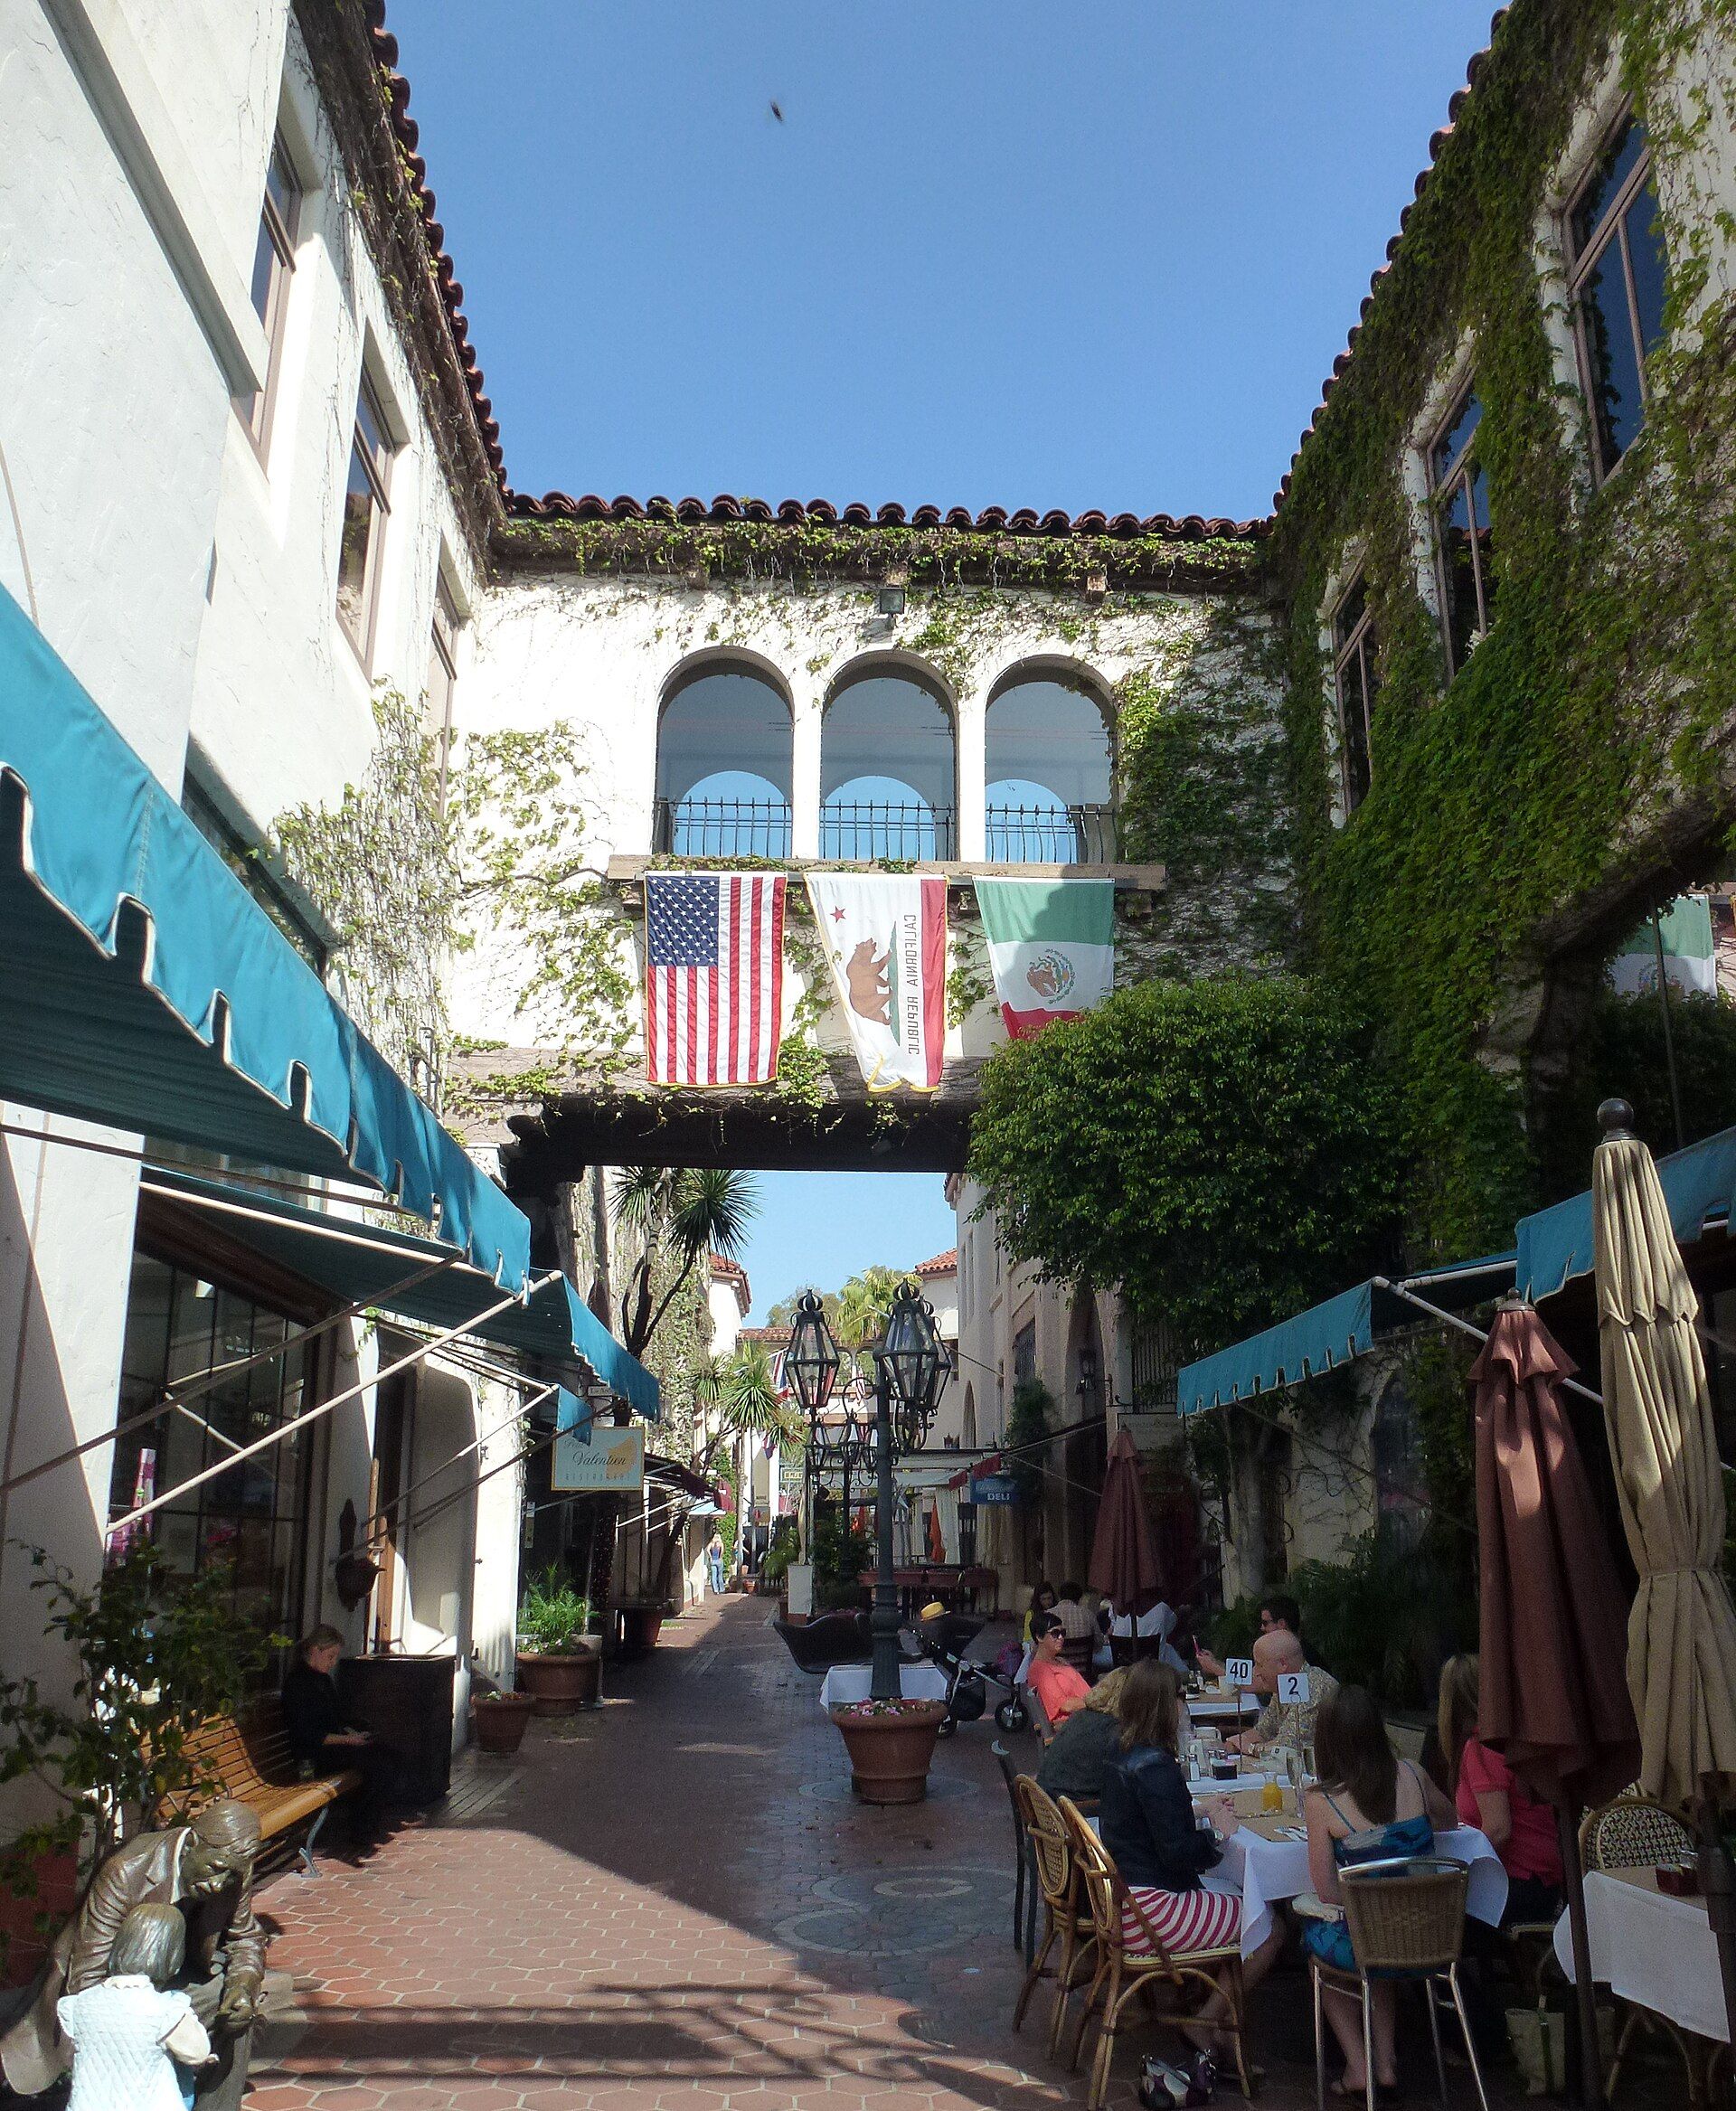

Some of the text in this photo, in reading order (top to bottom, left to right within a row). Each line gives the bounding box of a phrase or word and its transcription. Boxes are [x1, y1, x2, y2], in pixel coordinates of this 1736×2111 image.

[986, 1493, 1010, 1501] DELI
[1230, 1662, 1249, 1679] 40
[1288, 1676, 1299, 1695] 2
